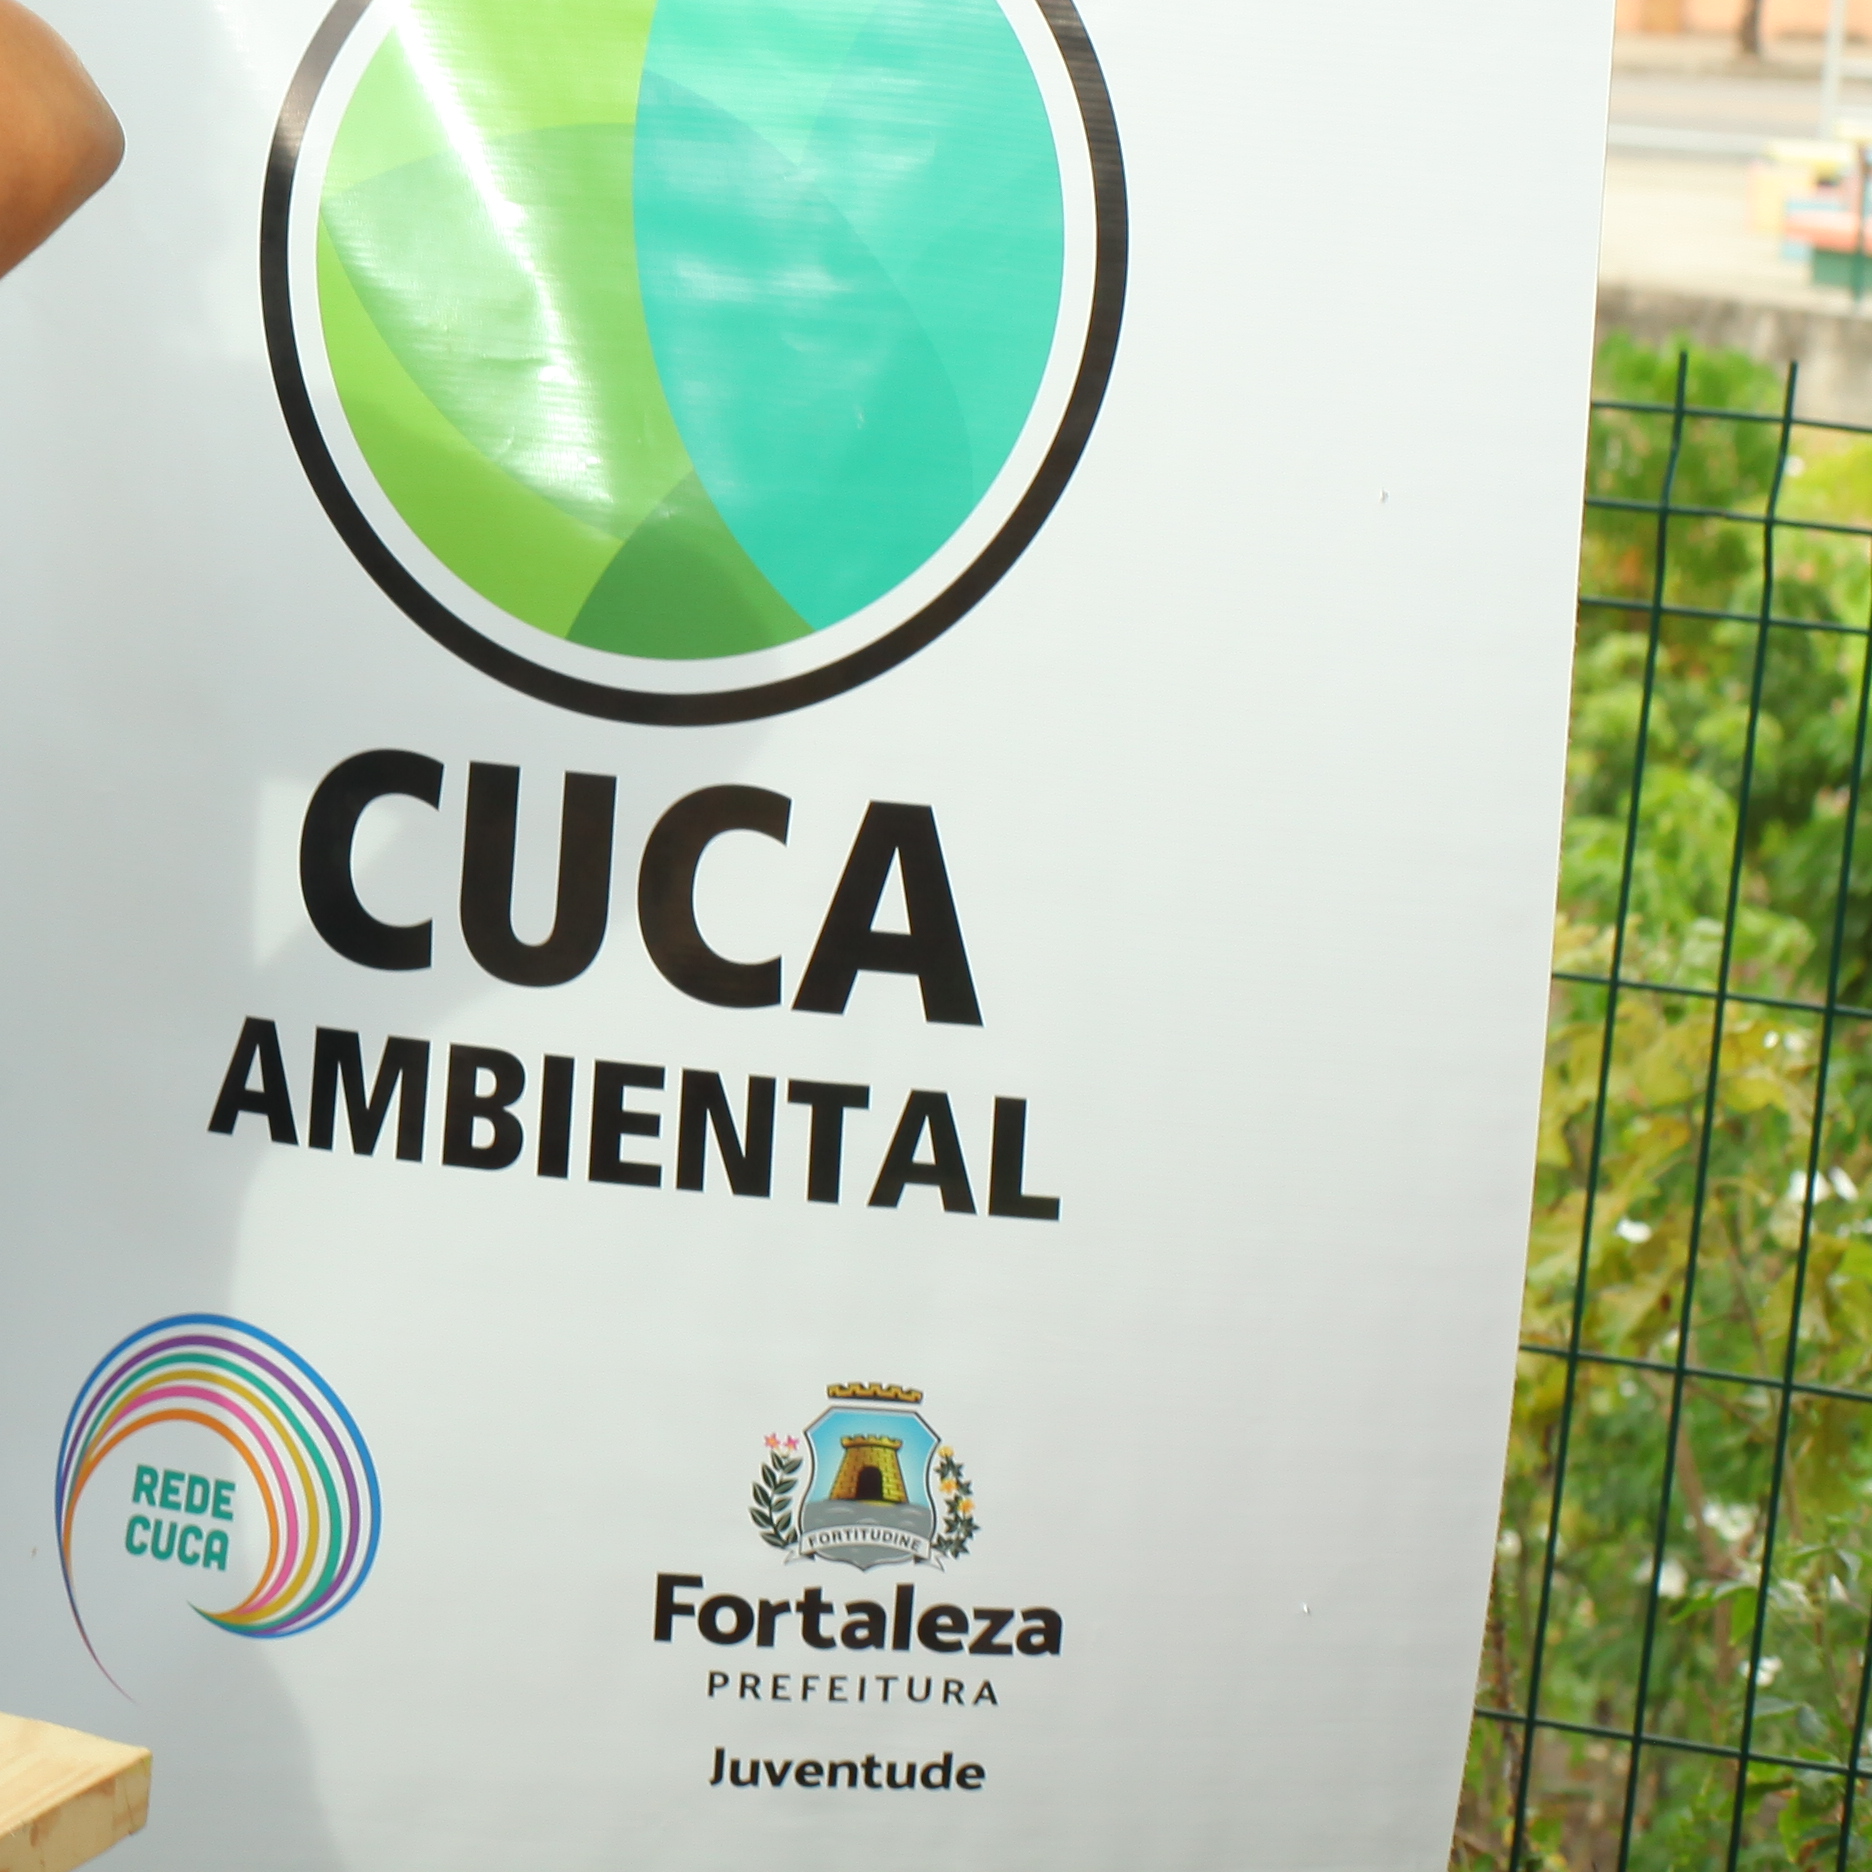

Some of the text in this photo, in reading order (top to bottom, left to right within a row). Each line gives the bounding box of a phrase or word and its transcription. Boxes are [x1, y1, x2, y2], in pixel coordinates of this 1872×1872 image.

[298, 747, 985, 1027] CUCA
[206, 1014, 1062, 1222] AMBIENTAL
[132, 1463, 236, 1522] REDE
[125, 1514, 230, 1572] CUCA
[808, 1527, 922, 1552] FORTITUDINE
[653, 1571, 1064, 1657] Fortaleza
[707, 1669, 1000, 1707] PREFEITURA
[709, 1745, 988, 1791] Juventude
